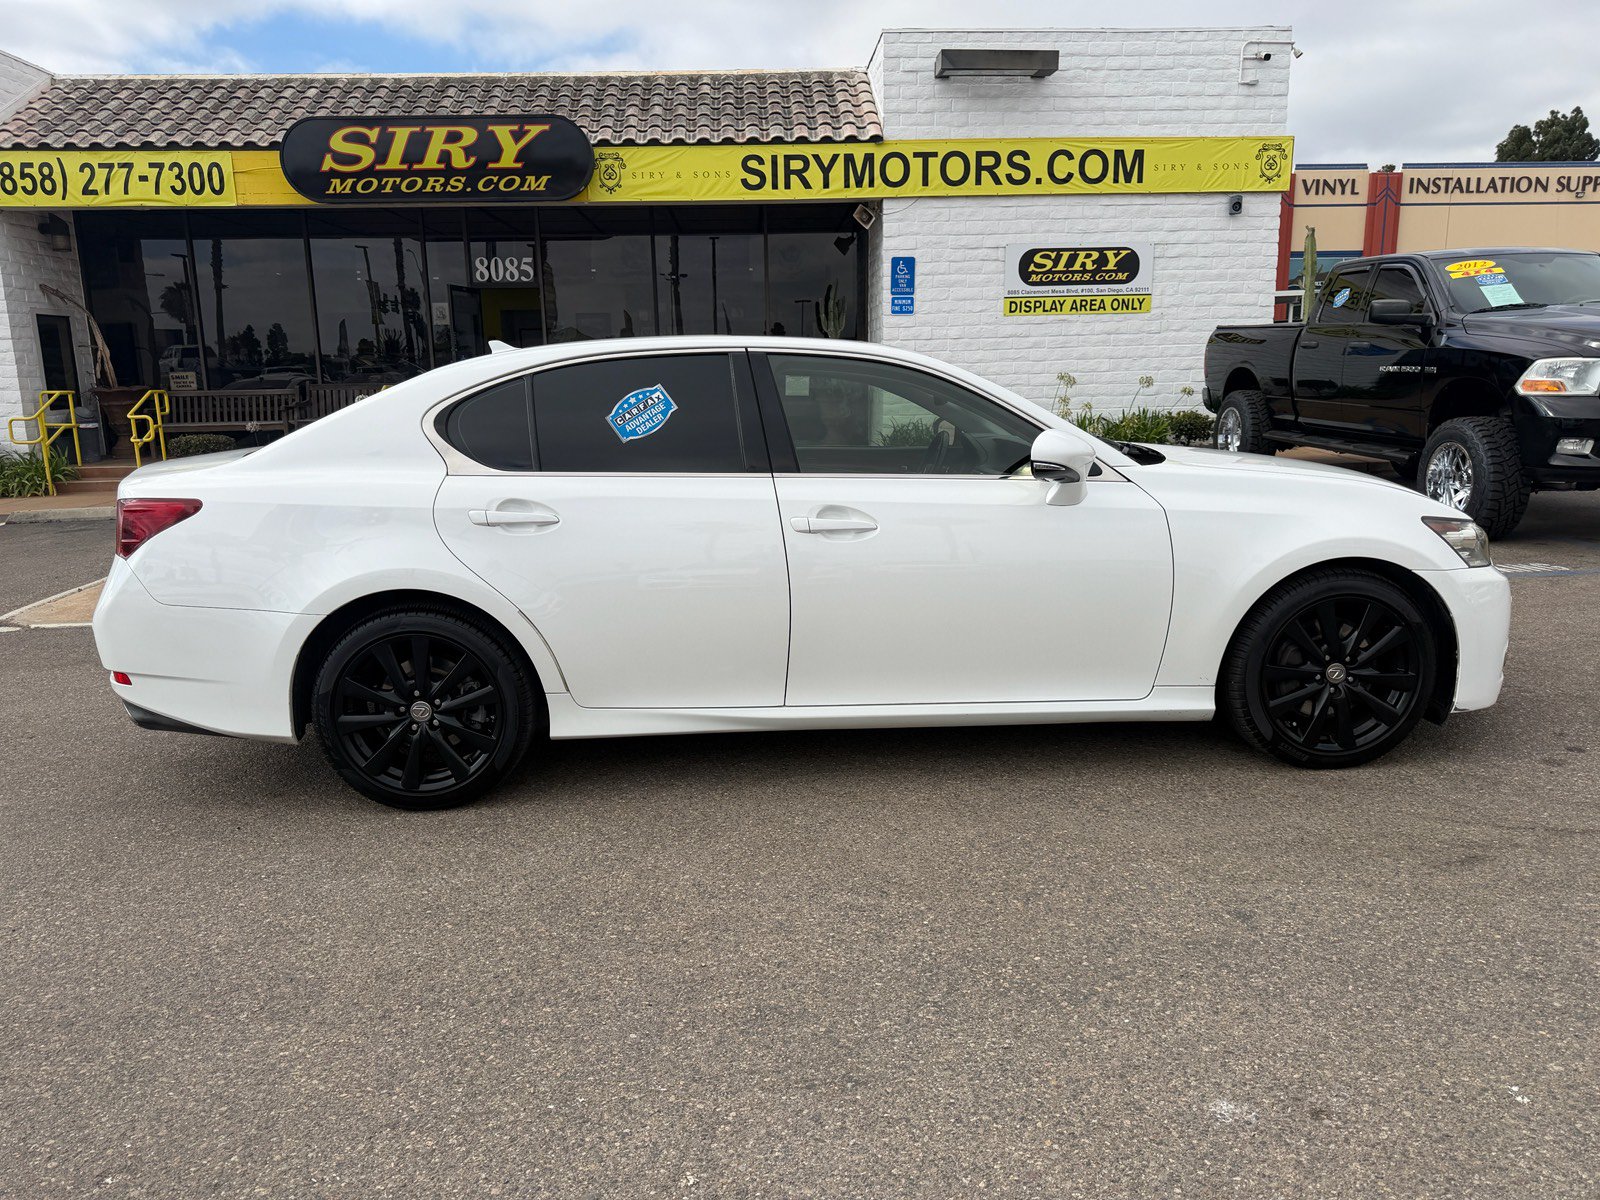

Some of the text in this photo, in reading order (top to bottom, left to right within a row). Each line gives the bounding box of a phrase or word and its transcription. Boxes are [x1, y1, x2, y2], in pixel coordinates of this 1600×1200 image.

[320, 124, 550, 172] SIRY
[631, 170, 731, 179] SIRY & SONS
[740, 148, 1145, 191] SIRYMOTORS.COM
[1154, 162, 1250, 171] SIRY & SONS
[78, 161, 225, 196] 277-7300
[325, 175, 551, 195] MOTORS.COM
[1302, 178, 1360, 196] VINYL
[1408, 175, 1550, 194] INSTALLATION
[475, 256, 534, 282] 8085
[1028, 249, 1131, 272] SIRY
[1456, 261, 1487, 271] 2012
[1028, 272, 1130, 282] MOTORS.COM
[1008, 297, 1146, 313] DISPLAY AREA ONLY
[615, 394, 664, 425] CARFAX
[625, 402, 666, 432] ADVANTAGE
[636, 413, 664, 435] DEALER
